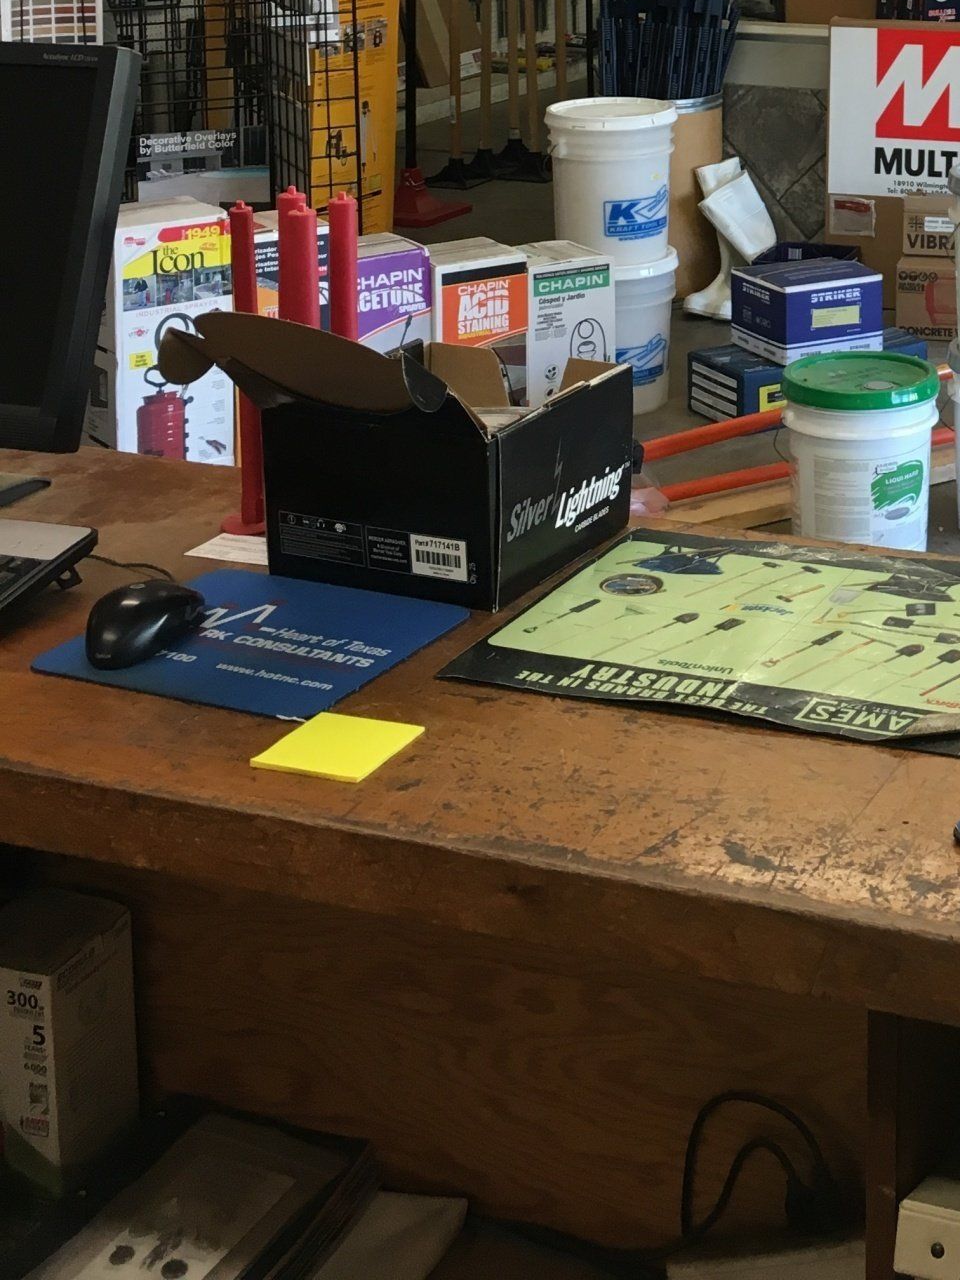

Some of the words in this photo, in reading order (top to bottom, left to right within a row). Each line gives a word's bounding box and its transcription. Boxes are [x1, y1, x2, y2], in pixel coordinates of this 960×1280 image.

[140, 135, 191, 146] Decorative
[194, 132, 236, 142] Overlays
[140, 146, 151, 155] by
[155, 142, 205, 153] Butterfield
[208, 140, 234, 149] Color
[186, 225, 220, 240] 1949
[163, 246, 178, 256] the
[151, 250, 205, 274] Icon
[458, 280, 509, 296] CHAPIN
[538, 275, 603, 293] CHAPIN
[742, 282, 770, 301] STRIKER
[811, 288, 861, 303] STRIKER
[136, 305, 181, 317] INDUSTRIAL
[184, 301, 218, 312] SPRAYER
[458, 290, 509, 321] ACID
[458, 315, 509, 334] STAINING
[507, 492, 556, 543] Silver
[574, 515, 593, 533] CARBIDE
[593, 506, 610, 523] BLADES
[429, 540, 460, 551] 717141B
[233, 635, 375, 668] CONSULTANTS
[322, 637, 346, 648] of
[347, 640, 392, 657] Texas
[514, 670, 553, 684] THE
[557, 677, 582, 688] IN
[570, 664, 735, 698] INDUSTRY
[585, 680, 670, 698] BRANDS
[670, 692, 727, 707] BEST
[728, 699, 768, 714] THE
[809, 704, 915, 733] AMES
[6, 990, 39, 1010] 300
[32, 1025, 46, 1045] 5
